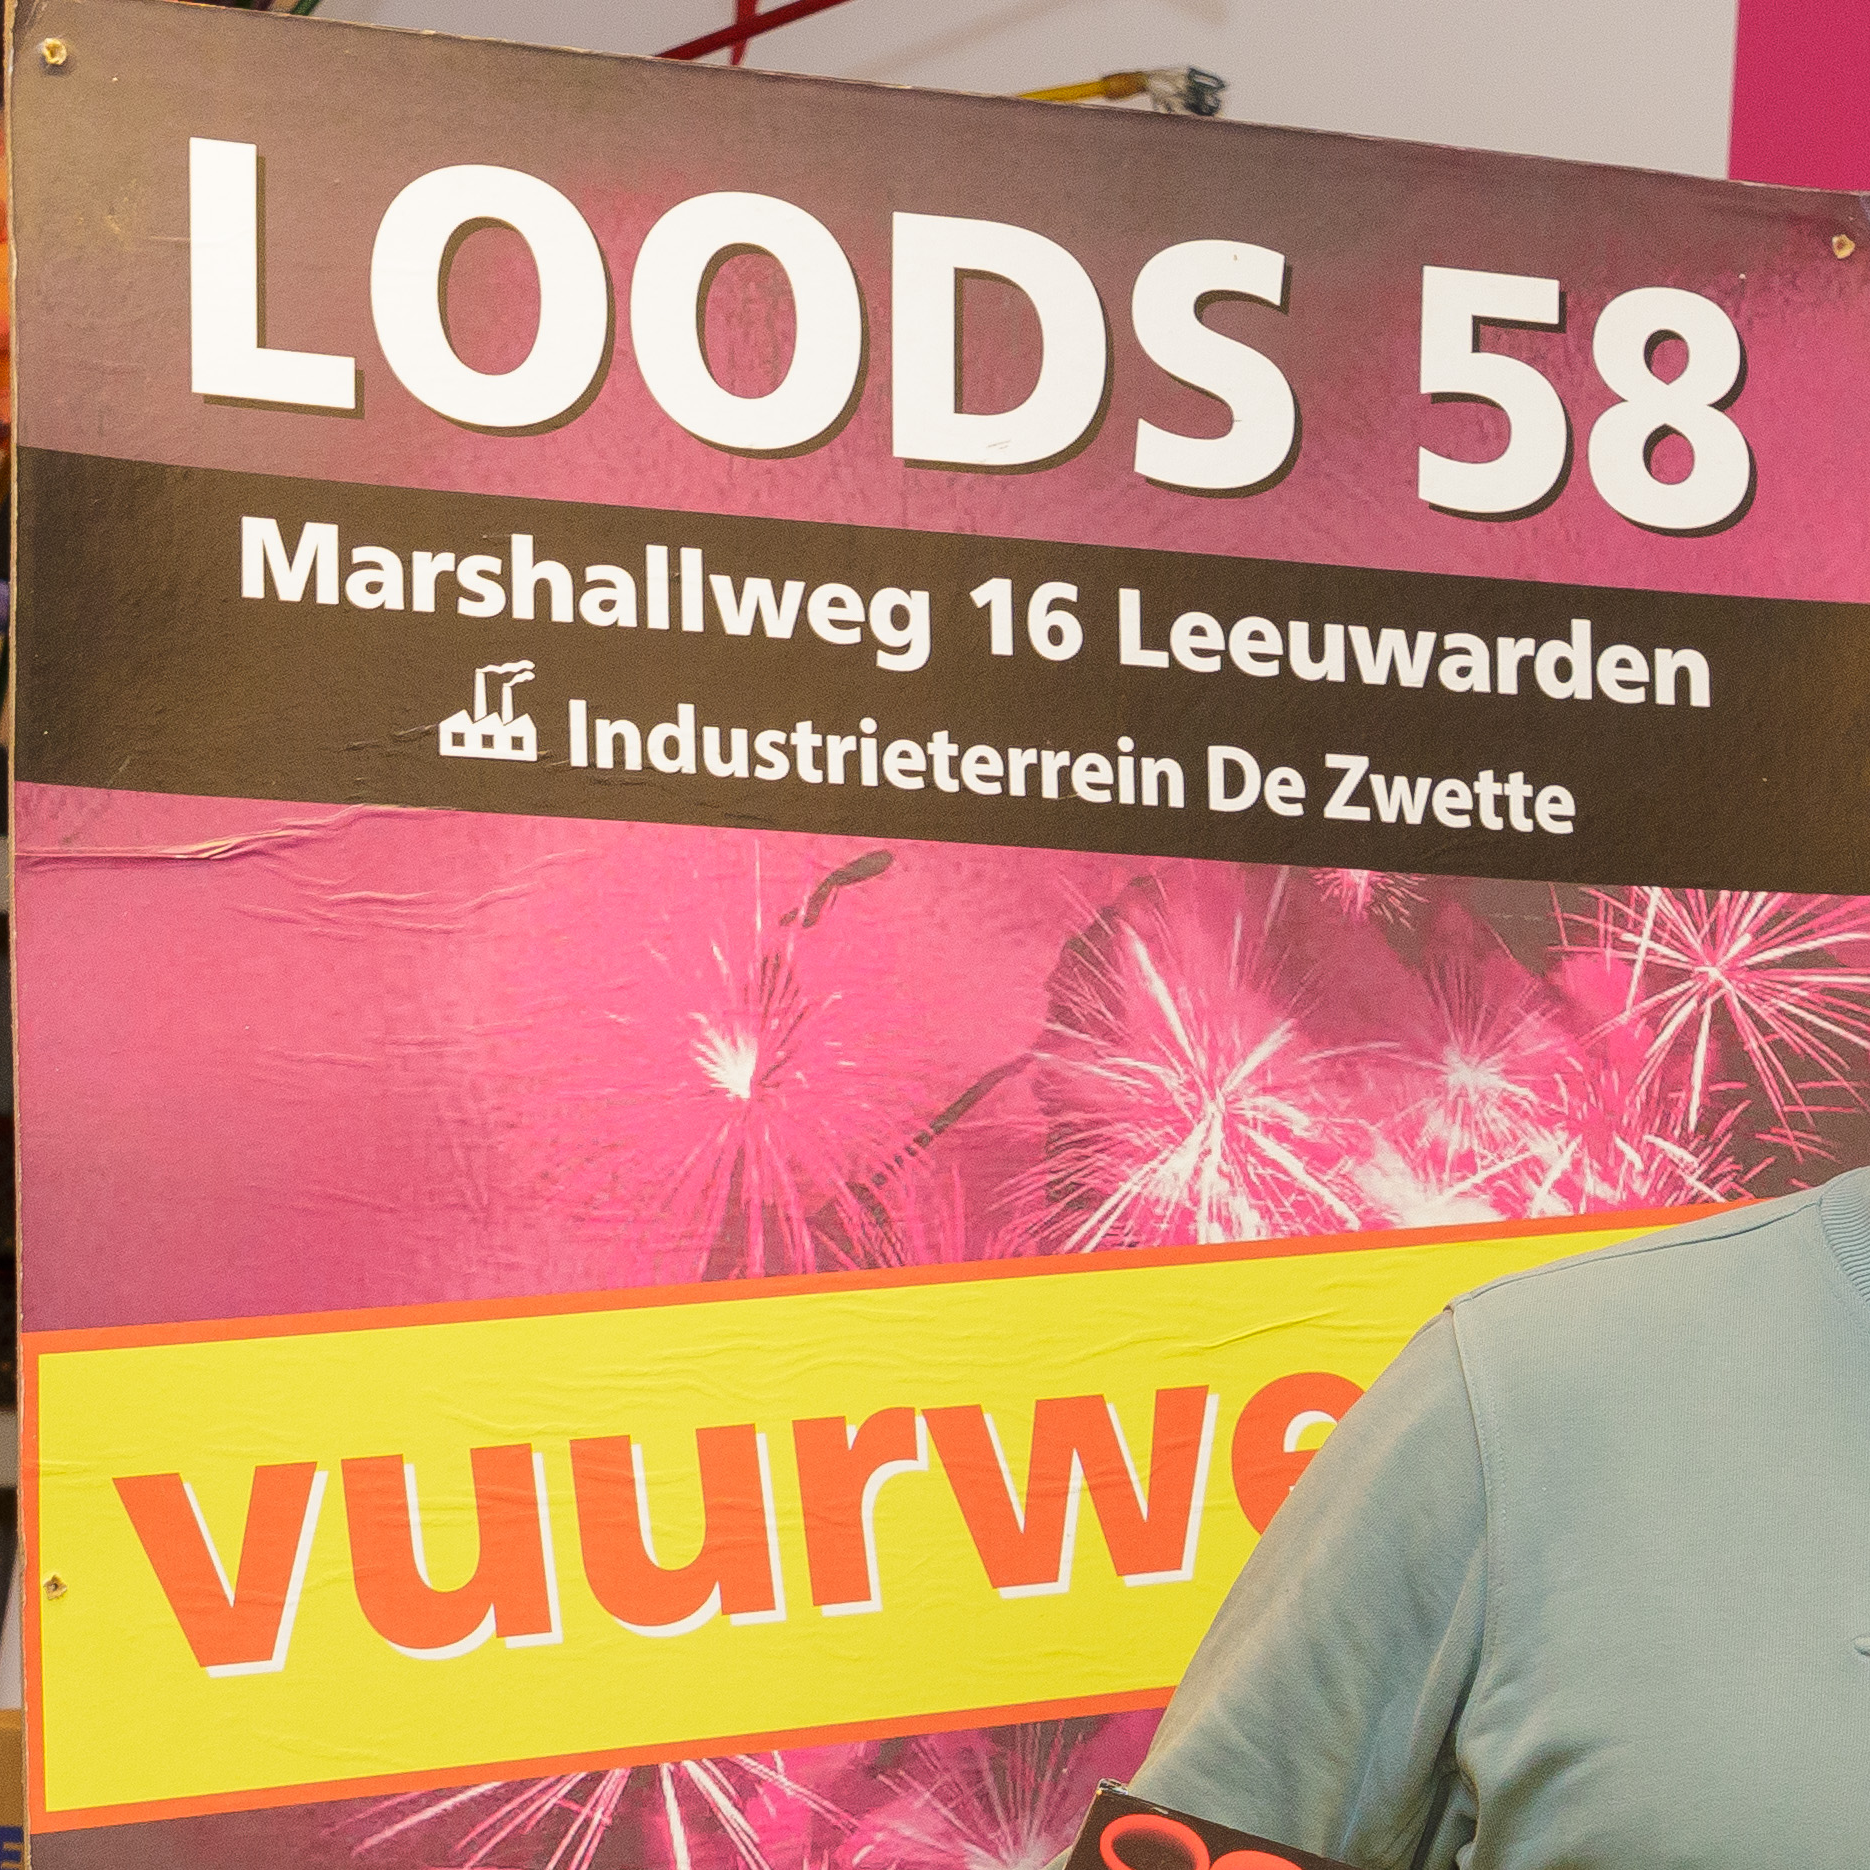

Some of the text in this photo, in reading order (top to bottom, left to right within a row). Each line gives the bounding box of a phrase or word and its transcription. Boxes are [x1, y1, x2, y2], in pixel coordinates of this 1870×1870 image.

[189, 135, 1759, 537] LOODS 58
[238, 515, 1712, 710] Marshallweg 16 Leeuwarden
[569, 697, 1577, 837] Industrieterrein De Zwette
